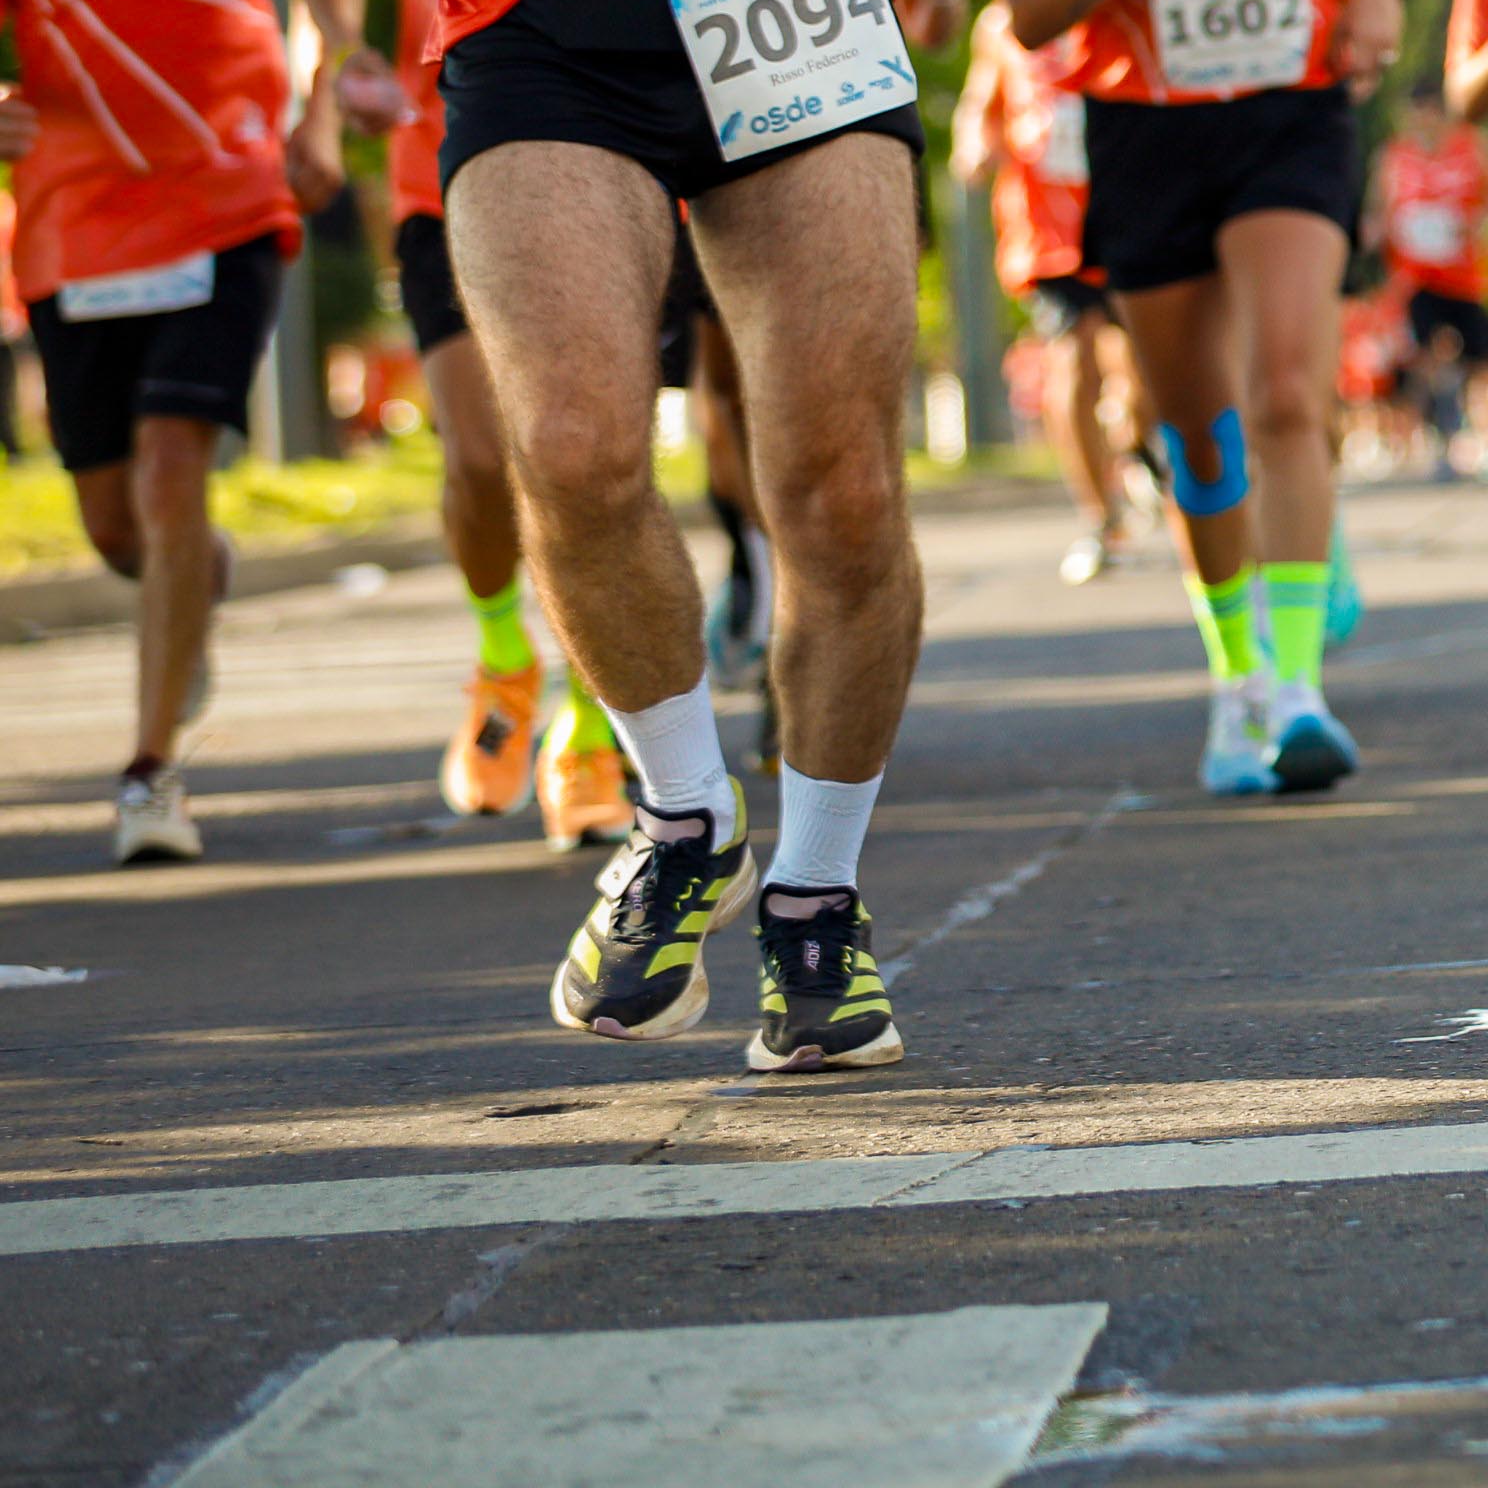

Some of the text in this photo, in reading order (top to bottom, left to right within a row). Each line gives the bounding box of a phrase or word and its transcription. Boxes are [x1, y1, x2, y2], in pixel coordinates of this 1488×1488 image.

[769, 47, 859, 87] Risso Federico
[751, 95, 824, 134] osde
